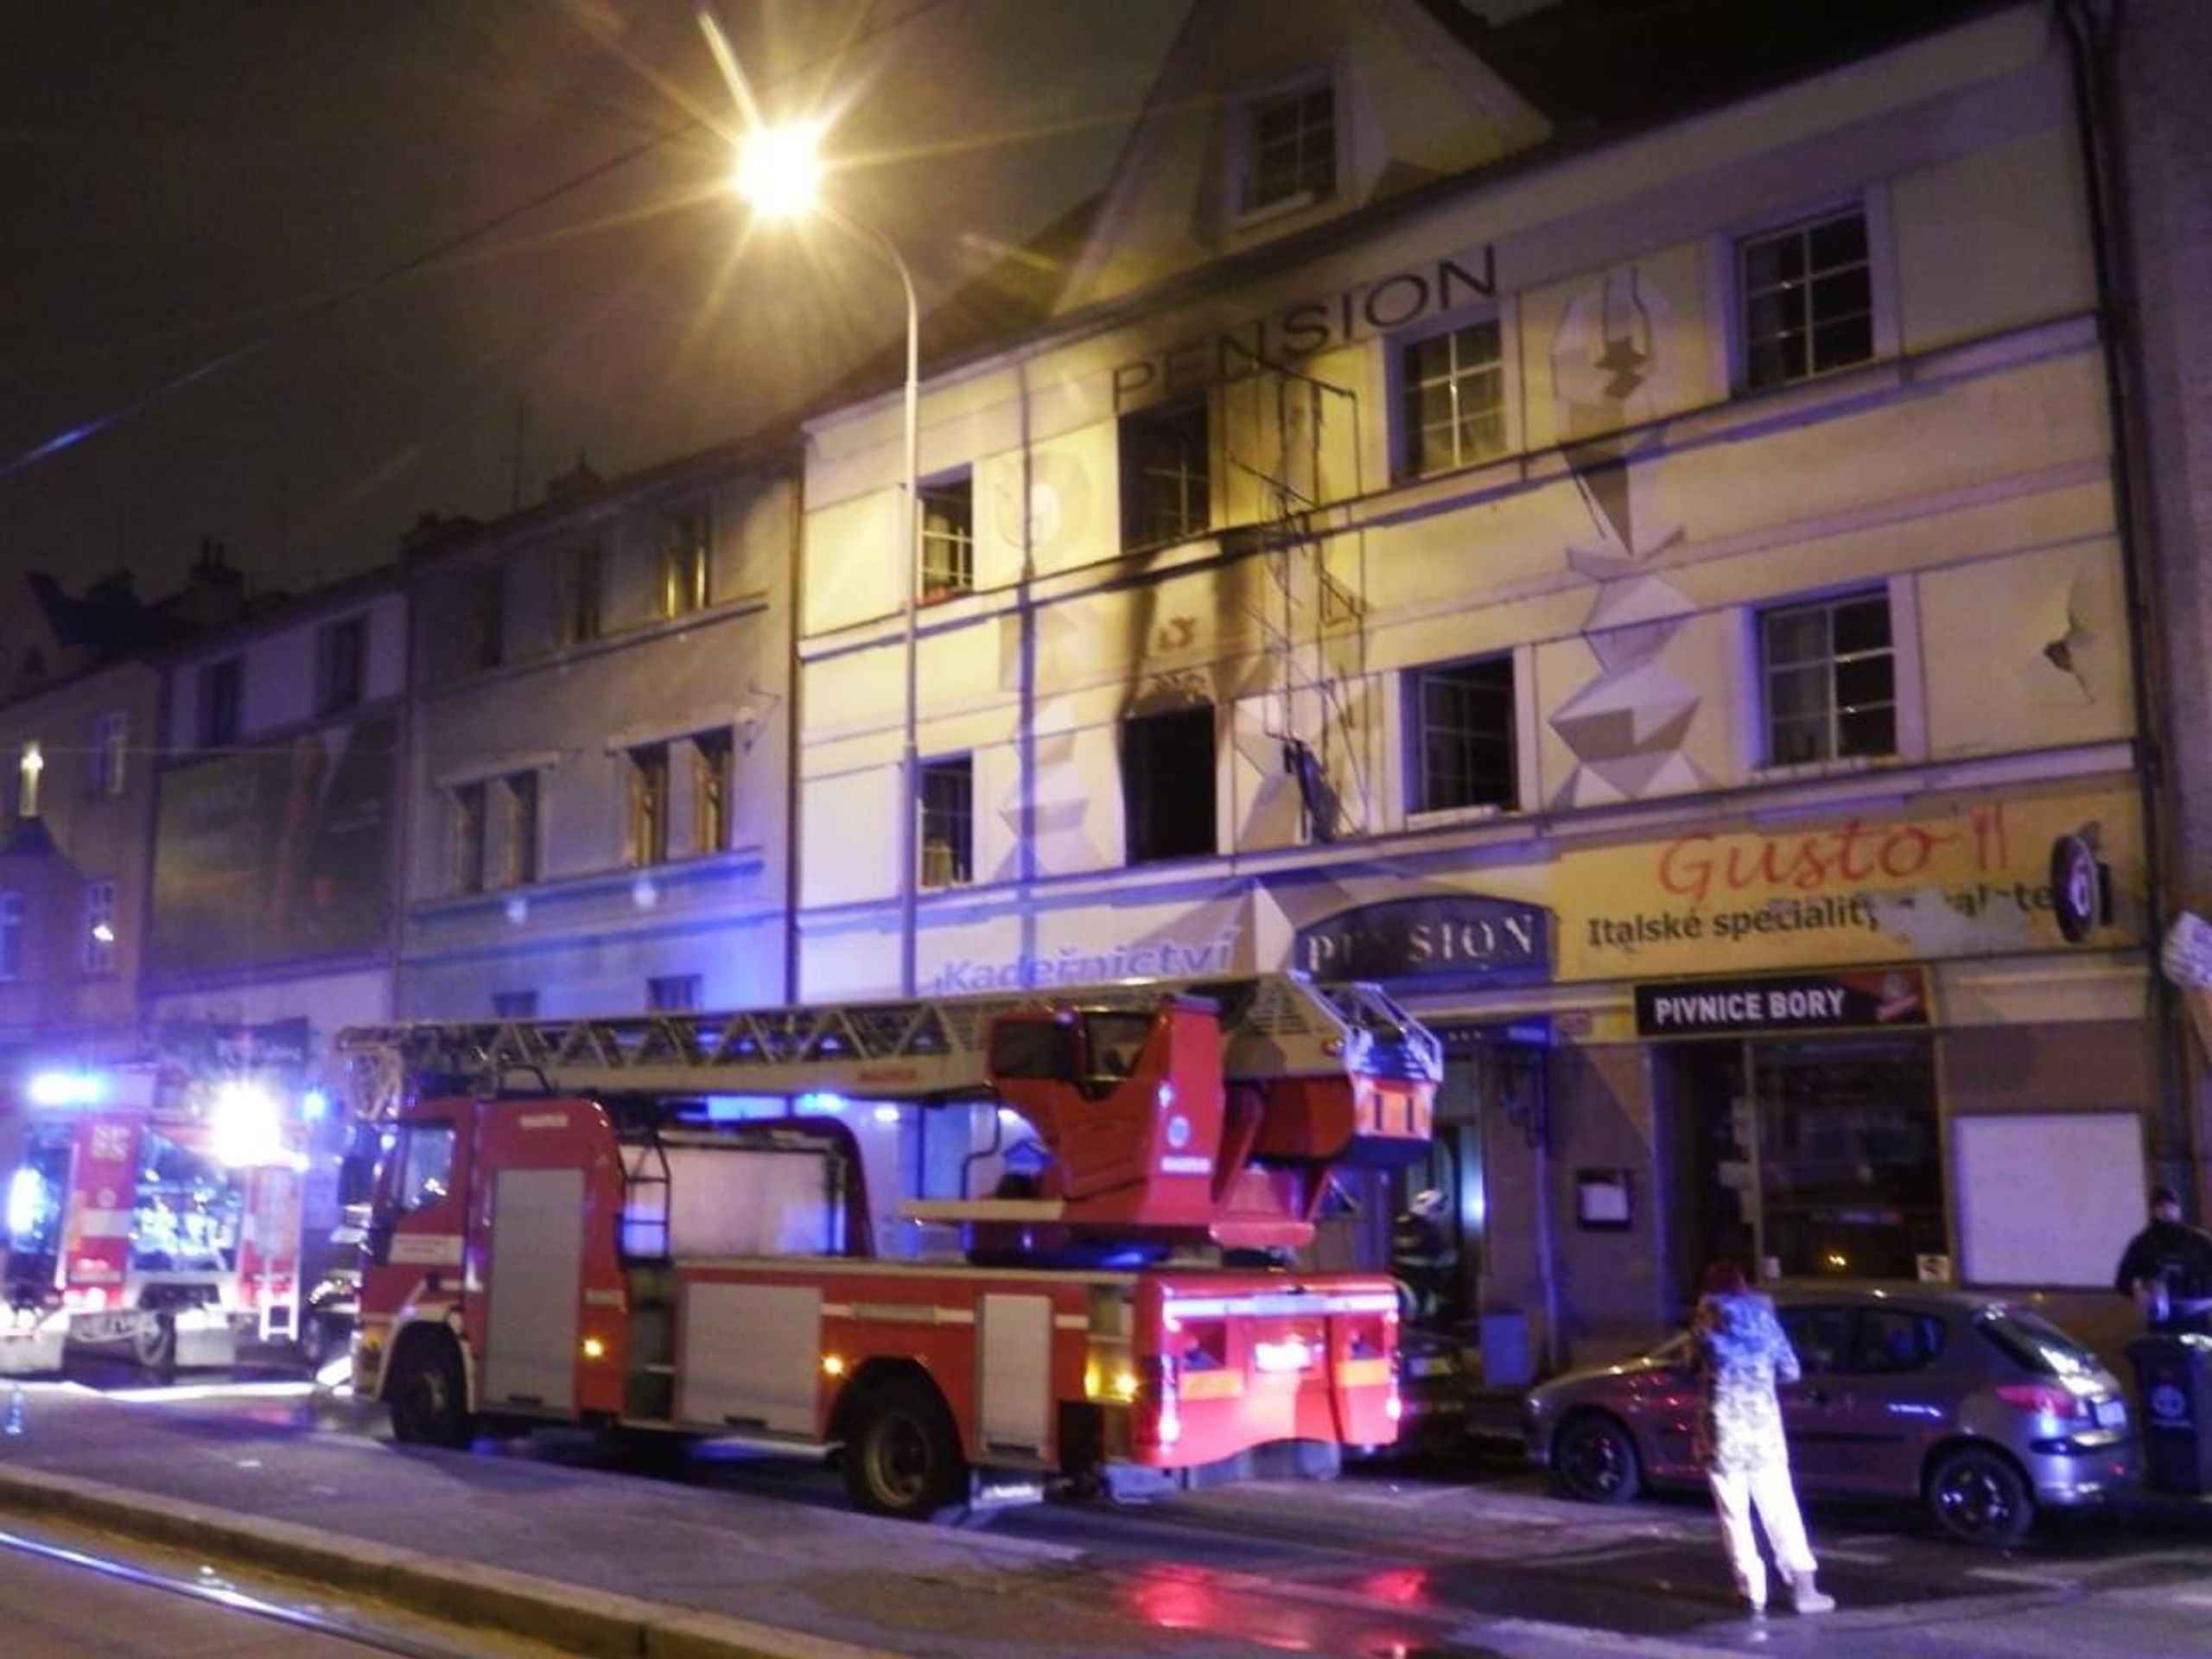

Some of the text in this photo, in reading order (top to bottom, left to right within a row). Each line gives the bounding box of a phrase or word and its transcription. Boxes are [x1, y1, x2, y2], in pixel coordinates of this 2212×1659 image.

[1112, 244, 1497, 412] PENSION
[1658, 816, 1961, 901] Gusto
[940, 925, 1243, 991] Kadeřnictví
[1307, 913, 1535, 973] PSION
[1587, 907, 1703, 947] Italské
[1654, 993, 1764, 1025] PIVNICE
[1770, 988, 1846, 1020] BORY
